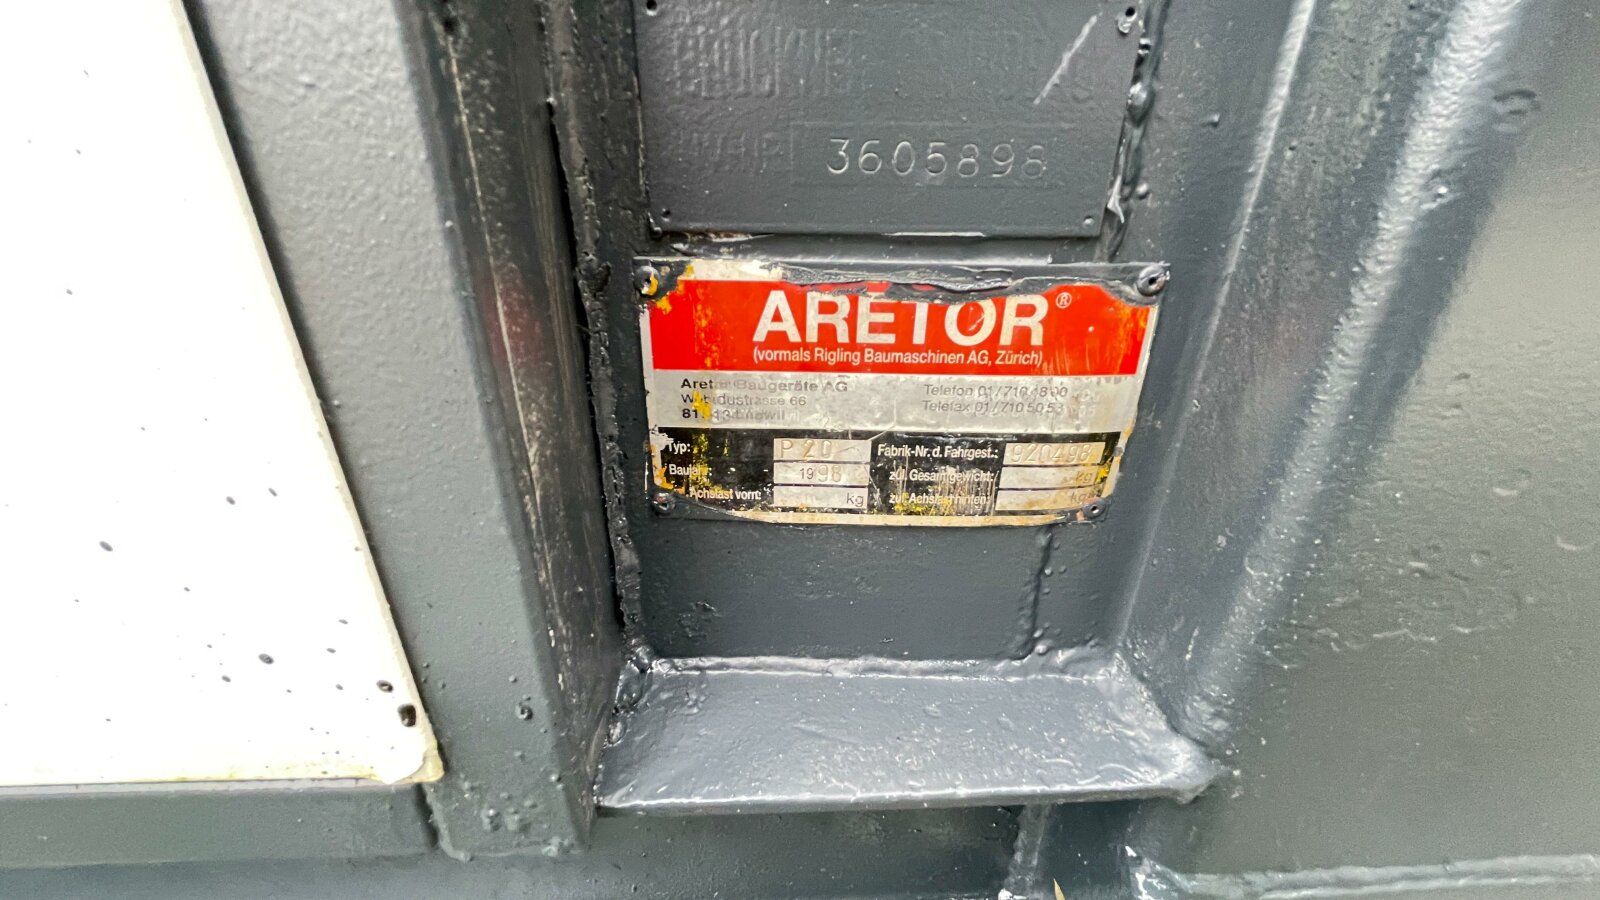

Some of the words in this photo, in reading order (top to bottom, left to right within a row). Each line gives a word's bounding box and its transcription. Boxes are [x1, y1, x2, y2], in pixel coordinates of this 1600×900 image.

[826, 138, 1045, 179] 3605898
[753, 346, 811, 363] (vormals
[814, 347, 861, 366] Rigling
[864, 349, 965, 365] Baumaschinen
[967, 350, 992, 366] AG,
[996, 349, 1043, 367] Zürich)
[925, 384, 972, 397] Telefon
[790, 395, 807, 406] 66
[923, 400, 969, 413] Telefax
[667, 440, 691, 455] Typ:
[779, 439, 794, 459] P
[800, 439, 833, 460] 20
[877, 443, 932, 458] Fabrik-Nr.
[933, 444, 943, 458] d.
[847, 493, 864, 507] kg
